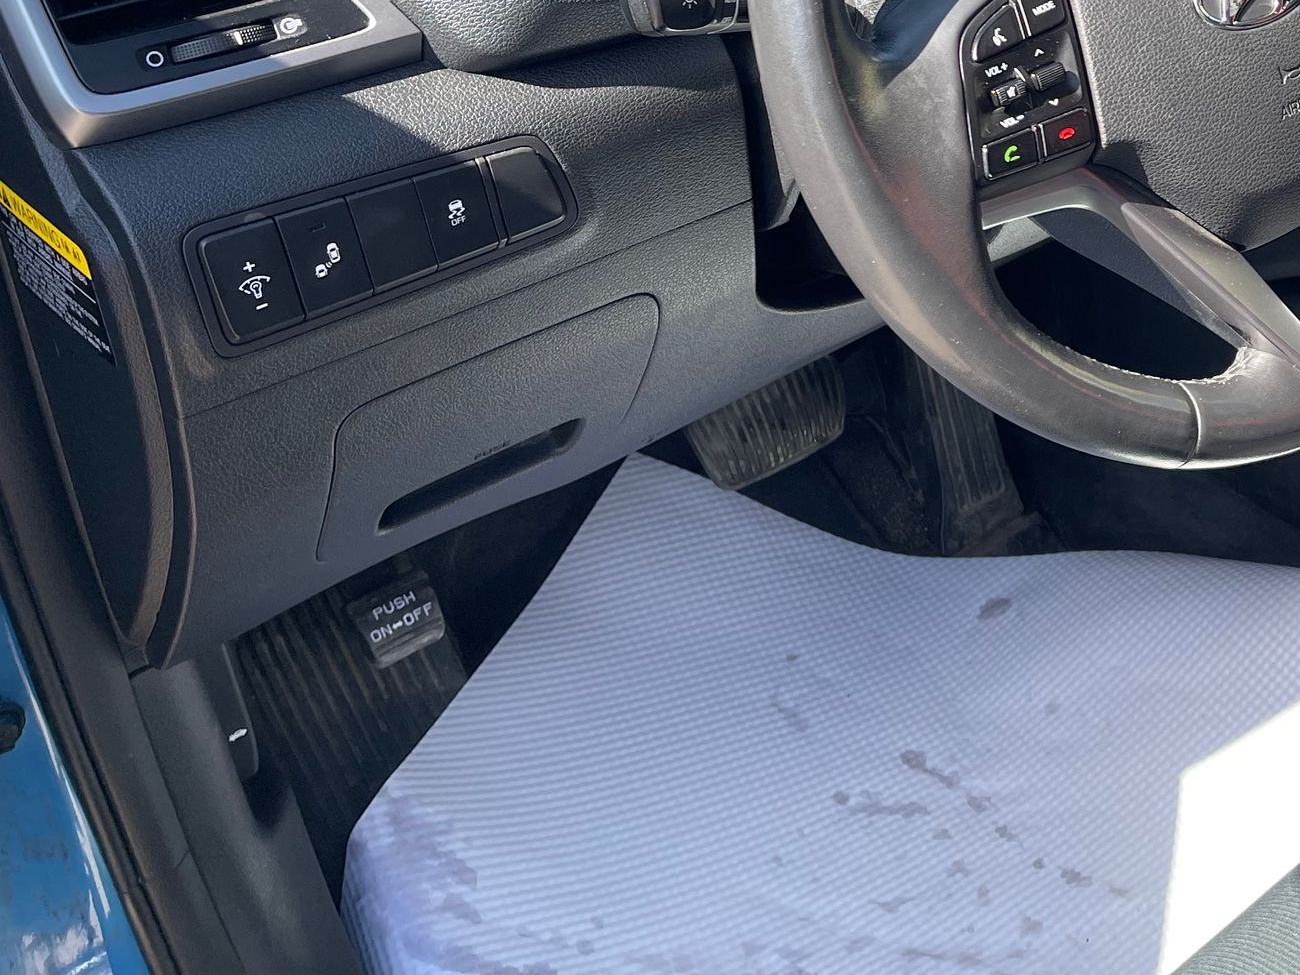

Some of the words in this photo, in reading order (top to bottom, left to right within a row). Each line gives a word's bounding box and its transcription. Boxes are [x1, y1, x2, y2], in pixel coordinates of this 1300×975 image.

[1032, 1, 1056, 16] MODE
[722, 16, 732, 24] OFF
[985, 63, 1008, 78] VOL+
[11, 195, 62, 251] WARNING
[450, 215, 467, 227] OFF
[372, 590, 417, 620] PUSH
[370, 623, 393, 643] ON
[402, 601, 433, 626] OFF
